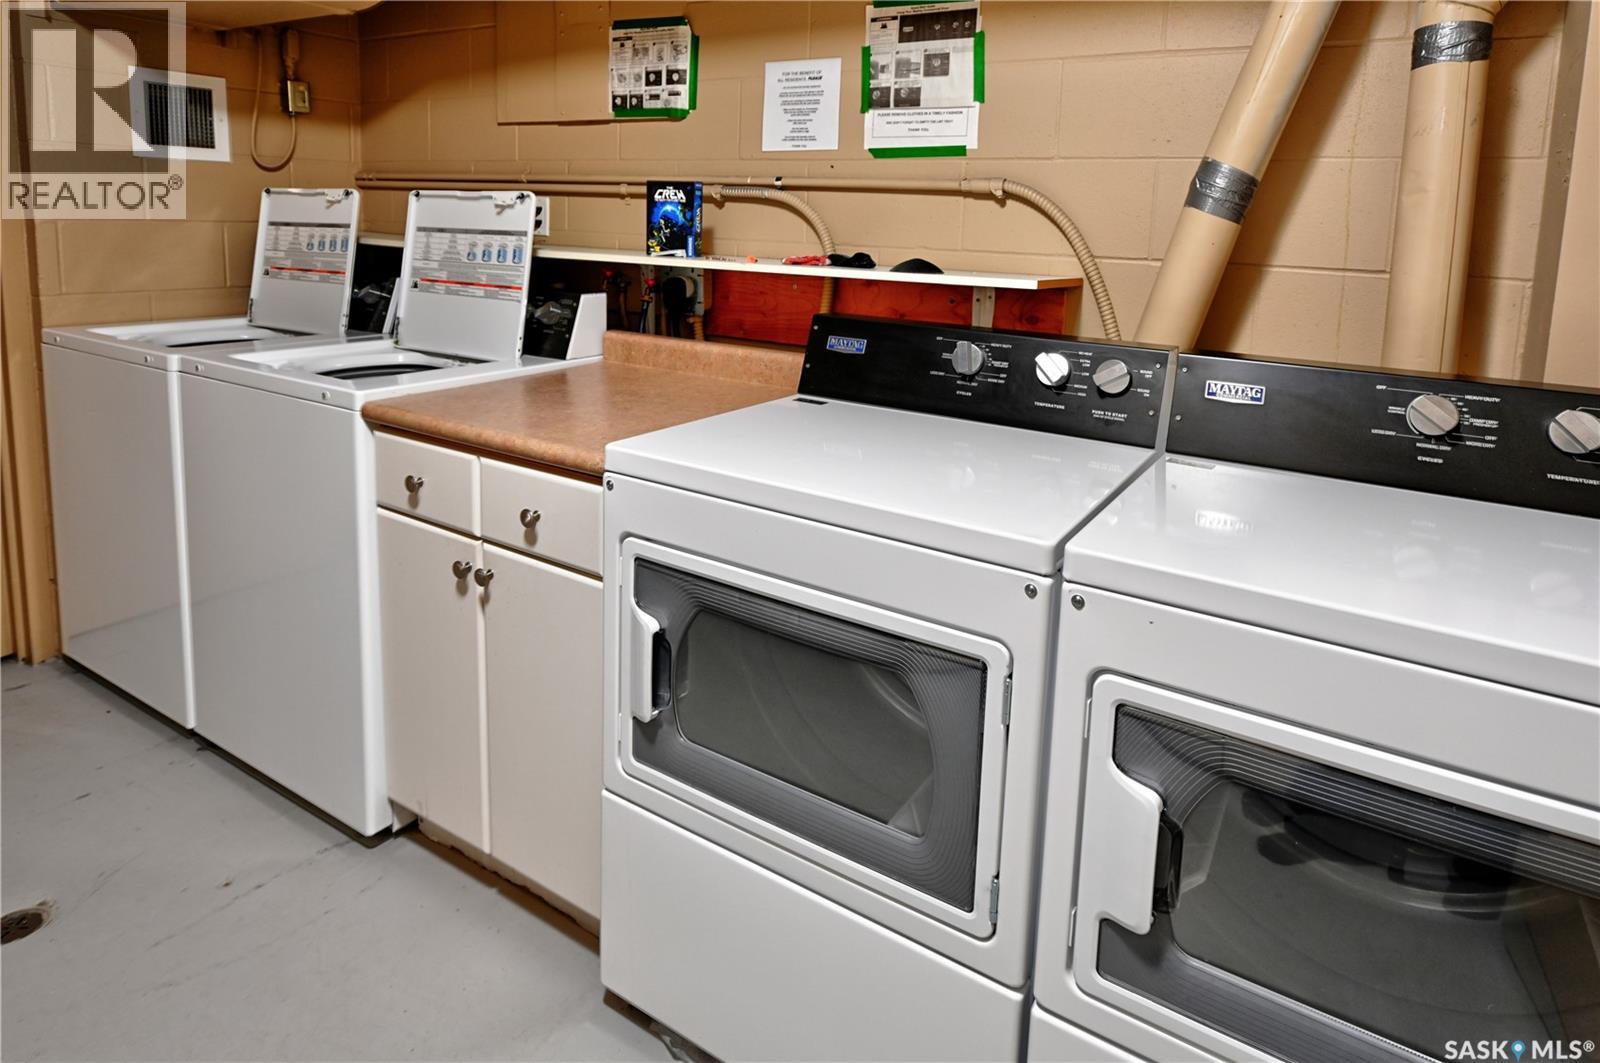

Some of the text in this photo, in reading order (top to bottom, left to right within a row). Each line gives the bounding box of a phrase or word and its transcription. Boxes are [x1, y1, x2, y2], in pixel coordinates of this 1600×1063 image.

[654, 189, 686, 201] CREW
[830, 337, 864, 350] MAYTAG
[1209, 383, 1262, 398] MAYTAG
[1034, 401, 1065, 410] TEMPERATURE
